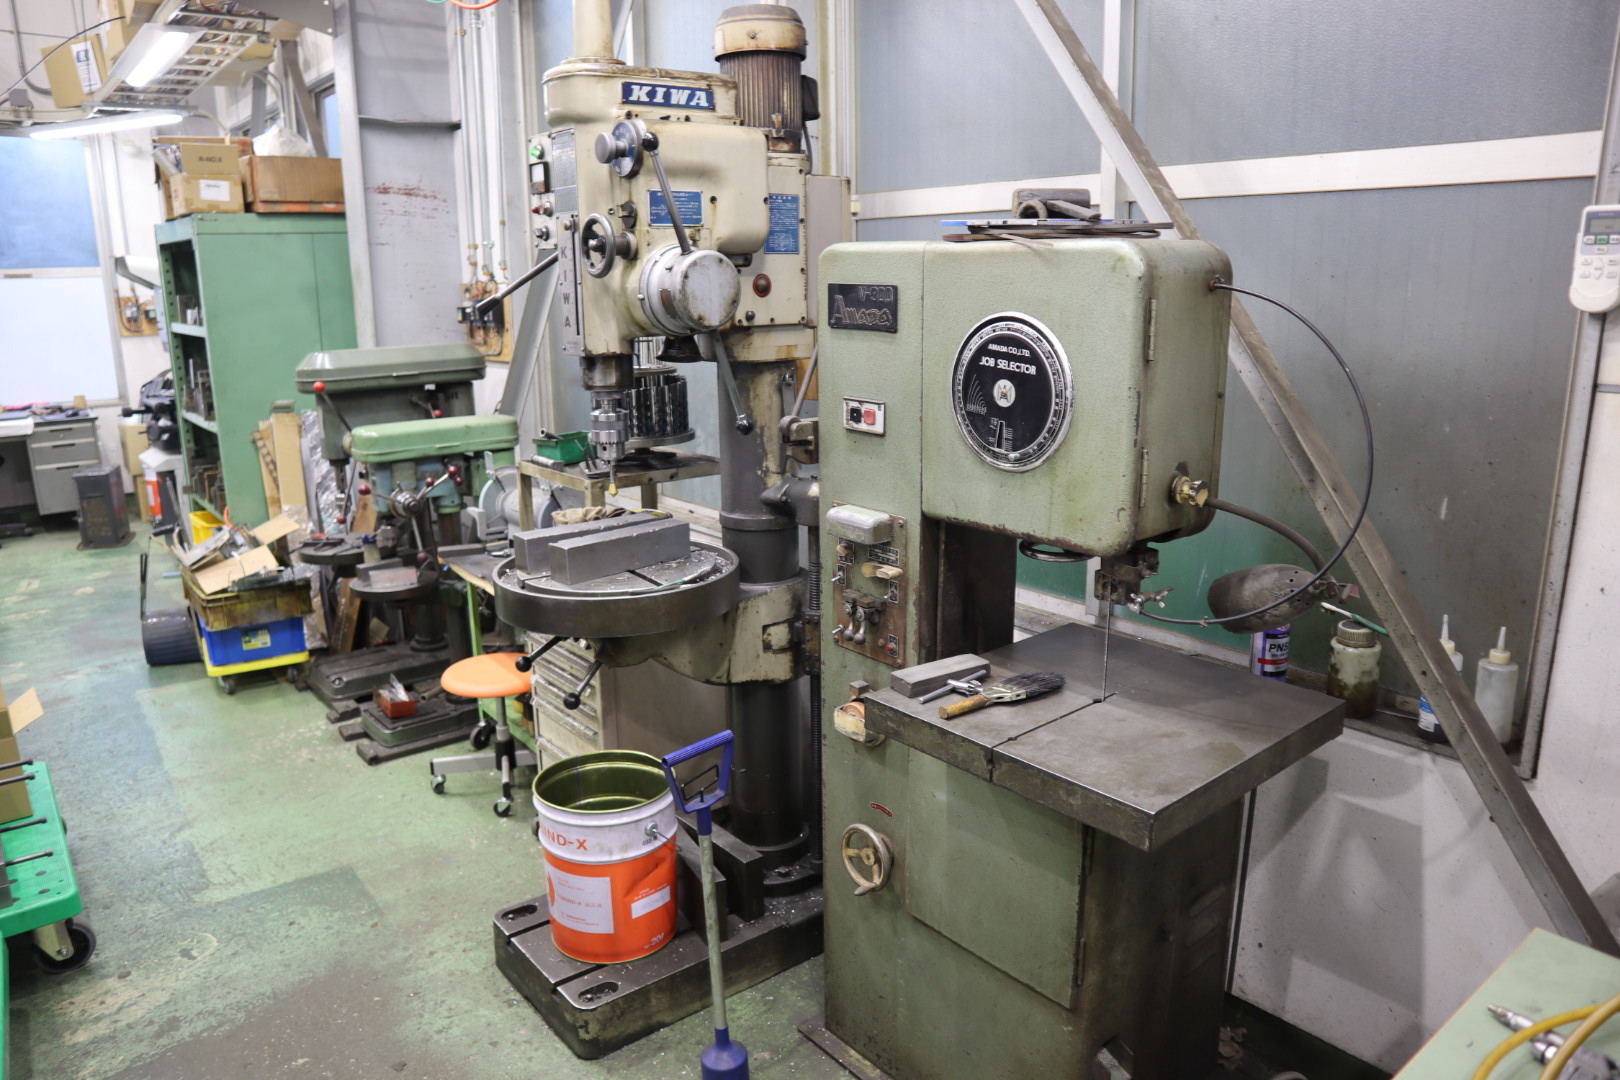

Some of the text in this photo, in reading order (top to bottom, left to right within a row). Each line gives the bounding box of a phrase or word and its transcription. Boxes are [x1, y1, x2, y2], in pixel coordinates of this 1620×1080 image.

[628, 85, 709, 107] KIWA
[561, 246, 572, 328] KIWA
[988, 343, 1008, 353] AMADA
[979, 356, 1037, 375] JOB SELECTOR
